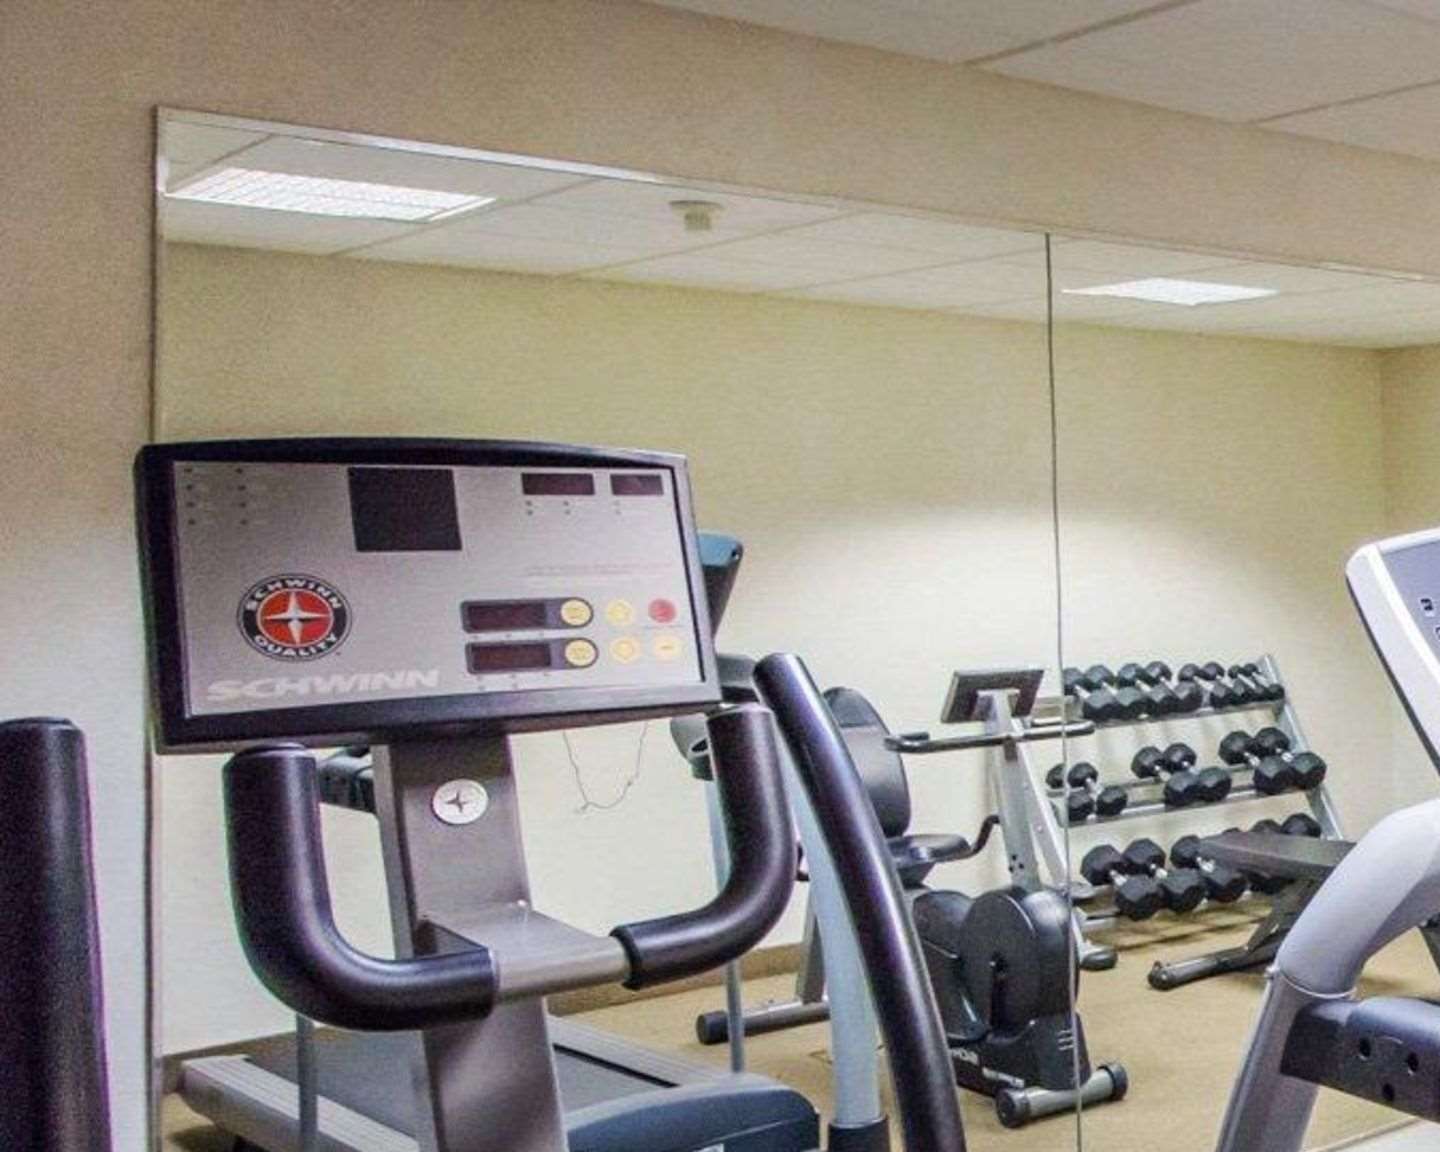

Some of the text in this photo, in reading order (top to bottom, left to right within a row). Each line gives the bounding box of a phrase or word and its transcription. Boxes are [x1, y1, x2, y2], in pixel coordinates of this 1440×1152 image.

[246, 578, 343, 611] SCHWINN
[254, 633, 338, 657] QUALITY
[207, 668, 440, 702] SCHWINN
